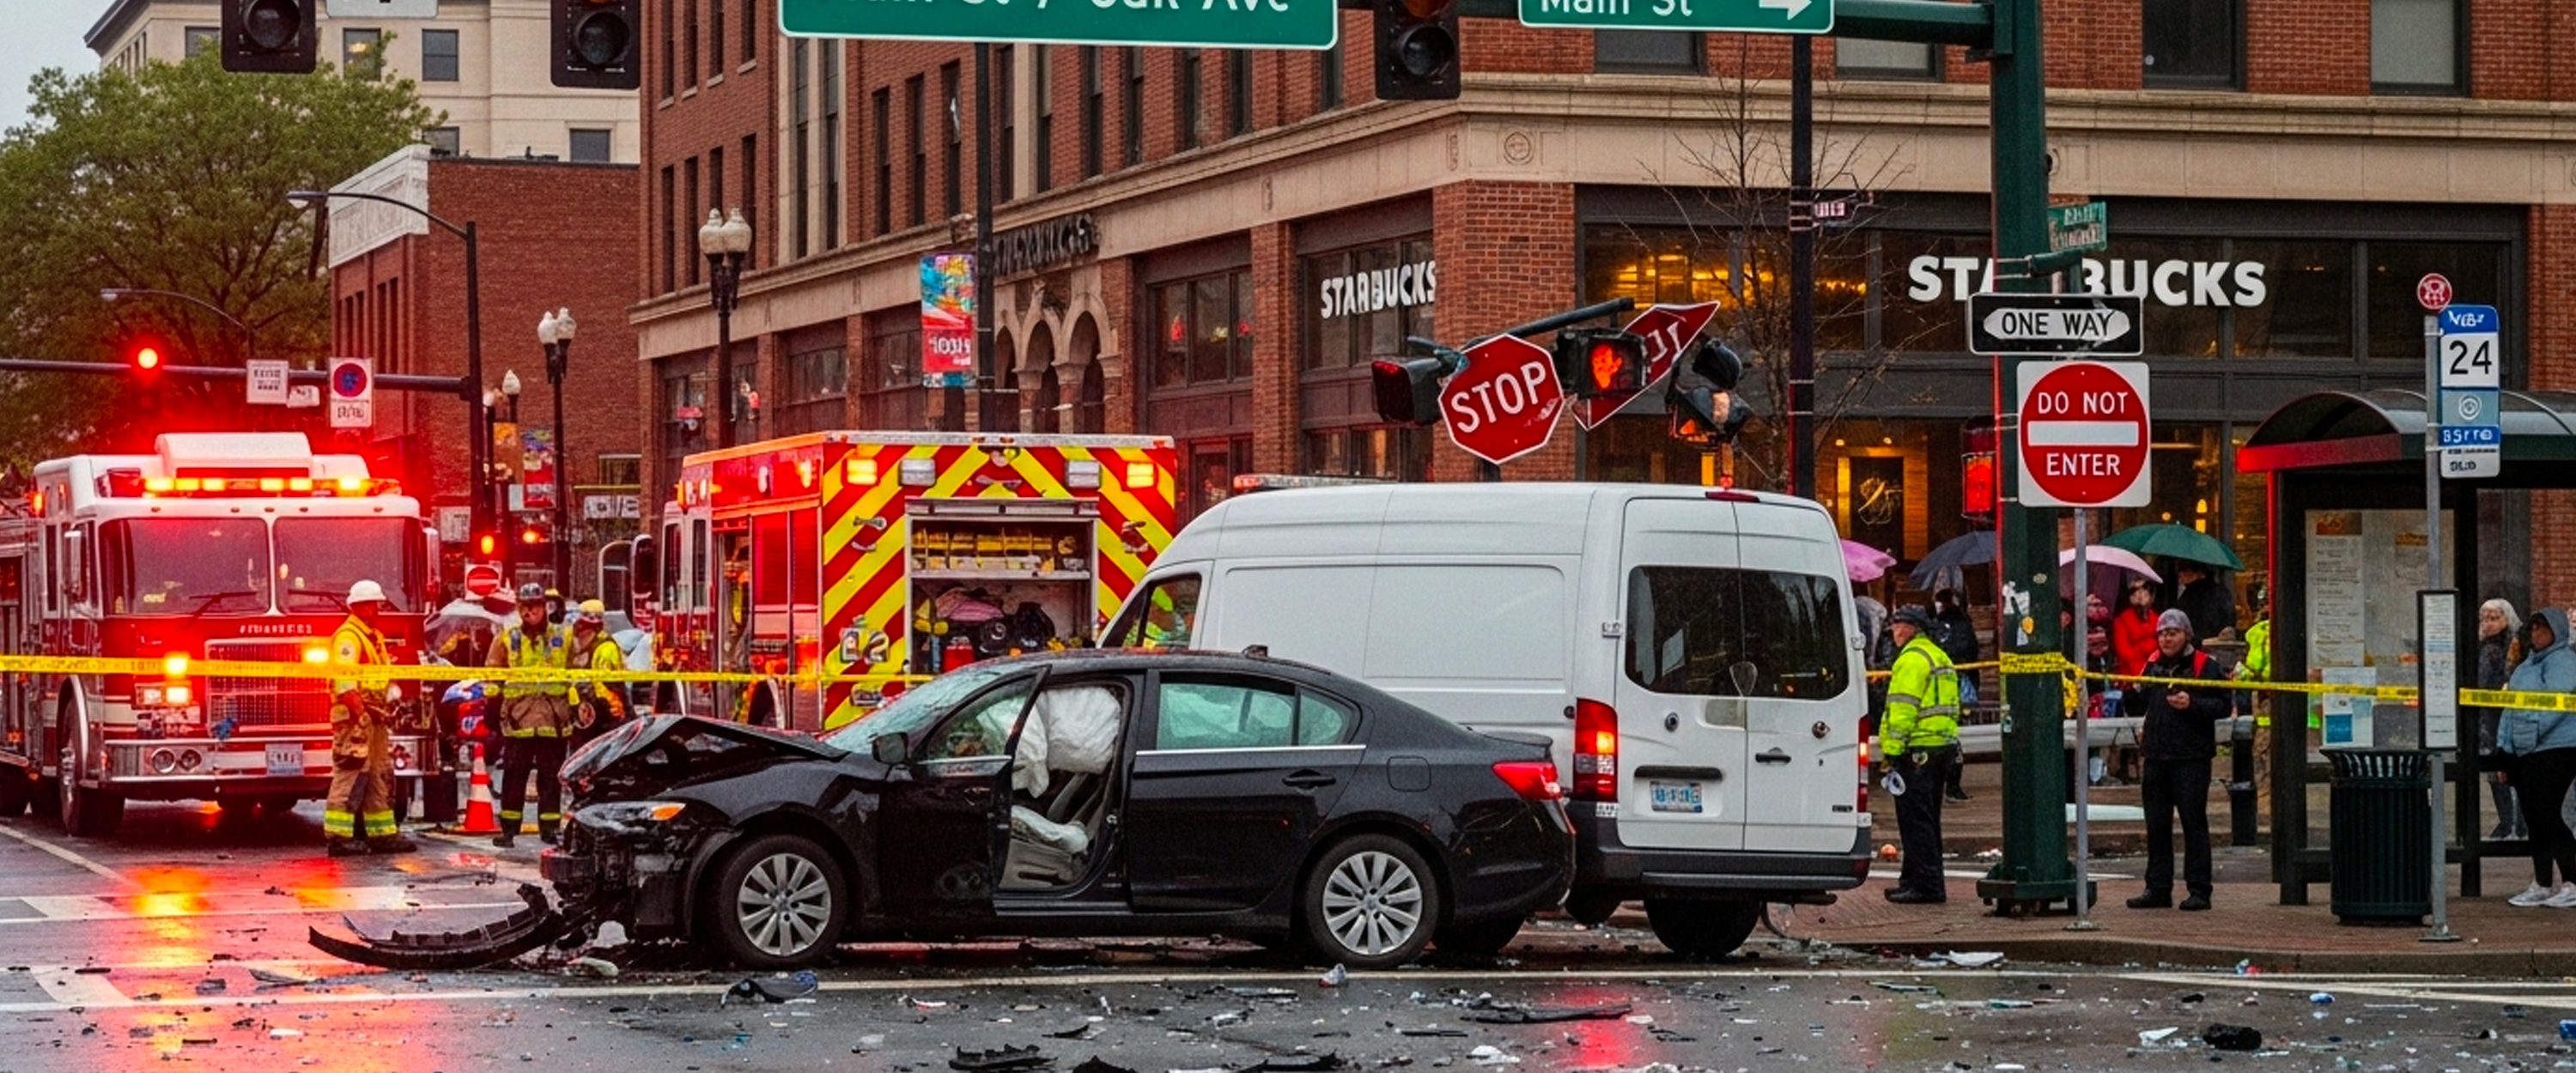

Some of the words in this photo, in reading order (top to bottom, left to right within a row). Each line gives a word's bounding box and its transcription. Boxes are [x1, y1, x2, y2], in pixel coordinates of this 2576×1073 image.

[1907, 255, 2268, 308] STBUCKS
[2002, 312, 2050, 336] ONE
[2063, 311, 2115, 337] WAY
[2449, 340, 2493, 375] 24
[1450, 361, 1546, 433] STOP
[2038, 391, 2069, 415] DO
[2083, 391, 2129, 415] NOT
[2046, 453, 2121, 476] ENTER
